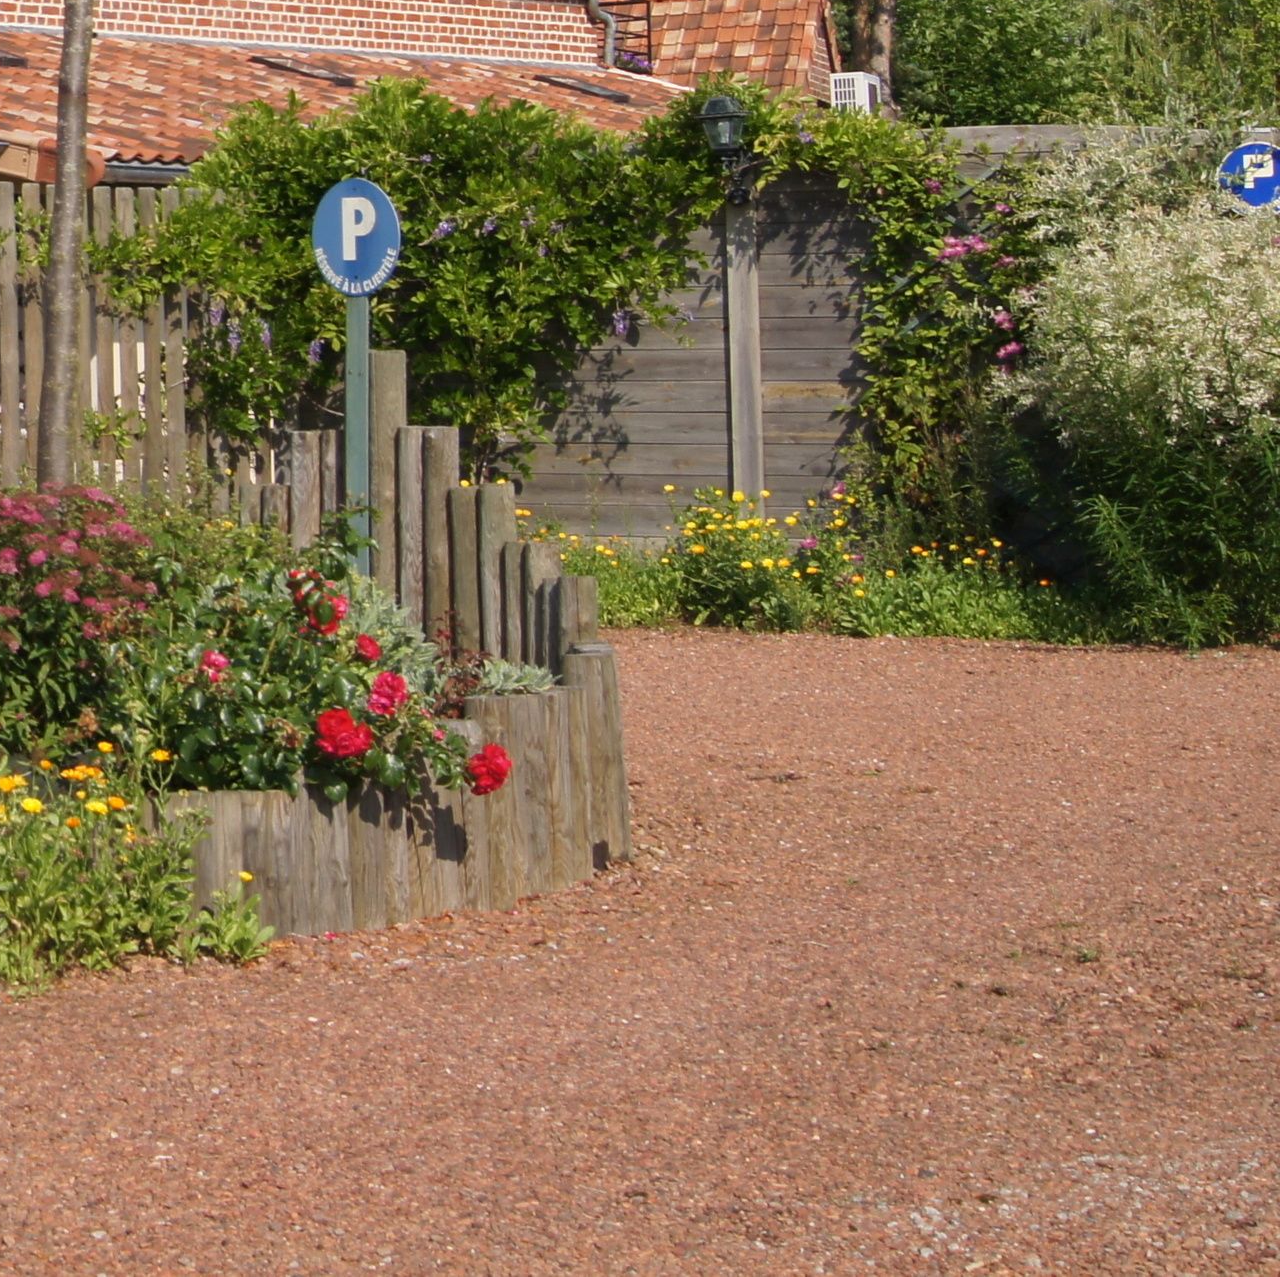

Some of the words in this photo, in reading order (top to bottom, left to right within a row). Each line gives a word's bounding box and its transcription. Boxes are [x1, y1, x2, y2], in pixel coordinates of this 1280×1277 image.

[1243, 153, 1275, 189] P
[341, 196, 376, 262] P
[314, 247, 344, 289] RÉSERVÉ
[342, 278, 349, 292] À
[351, 282, 362, 294] LA
[362, 247, 397, 292] CLIENTÈLE
